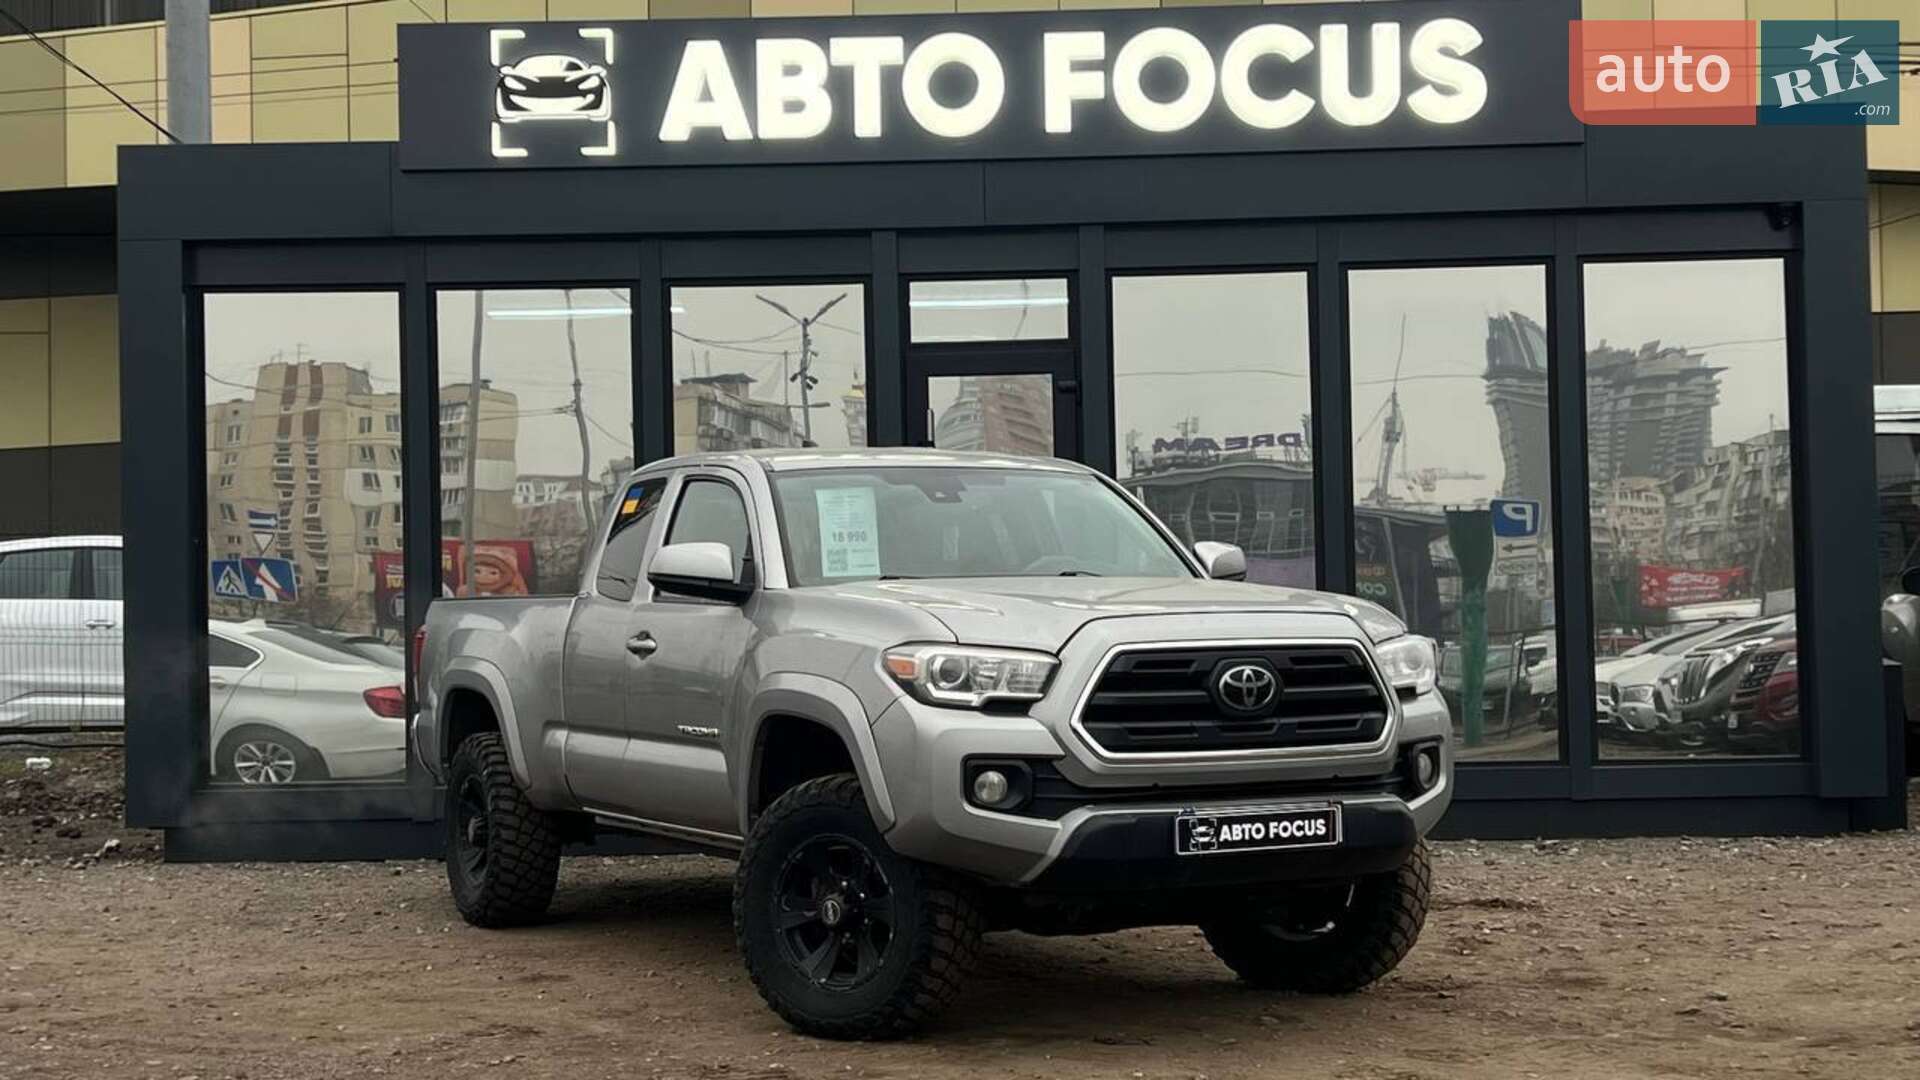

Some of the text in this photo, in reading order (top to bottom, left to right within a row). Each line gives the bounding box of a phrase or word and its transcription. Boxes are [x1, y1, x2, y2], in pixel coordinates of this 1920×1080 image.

[658, 18, 1488, 141] АВТО FOCUS
[1219, 819, 1327, 842] АВТО FOCUS
